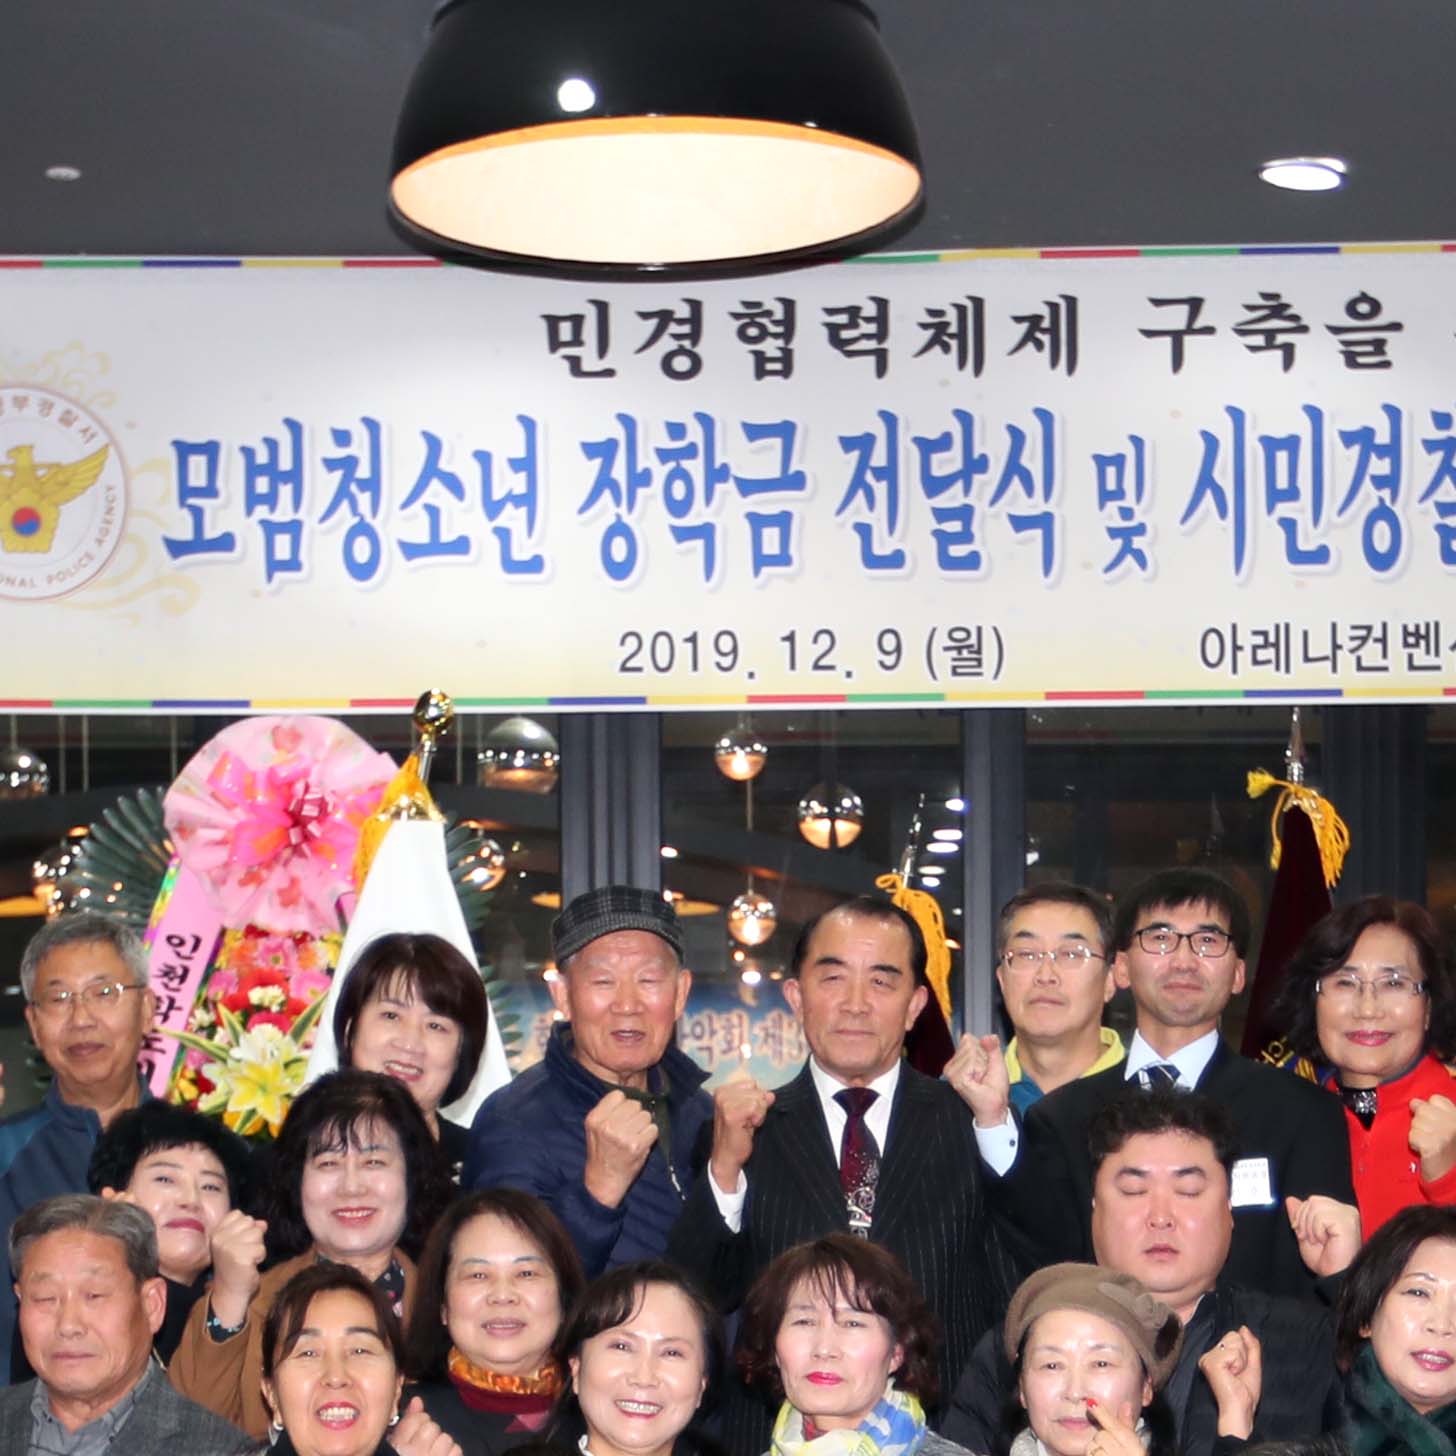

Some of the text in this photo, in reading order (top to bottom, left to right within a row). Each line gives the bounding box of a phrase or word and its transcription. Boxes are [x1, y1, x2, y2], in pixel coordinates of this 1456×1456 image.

[541, 295, 1078, 381] 민경협력체제
[1139, 291, 1404, 373] 구축을
[47, 551, 95, 586] POLICE
[95, 485, 117, 547] AGENCY
[162, 414, 545, 582] 모범청소년
[578, 411, 807, 581] 장학금
[838, 406, 1061, 578] 전달식
[1092, 434, 1147, 573] 및
[619, 630, 755, 679] 2019.
[780, 629, 852, 678] 12.
